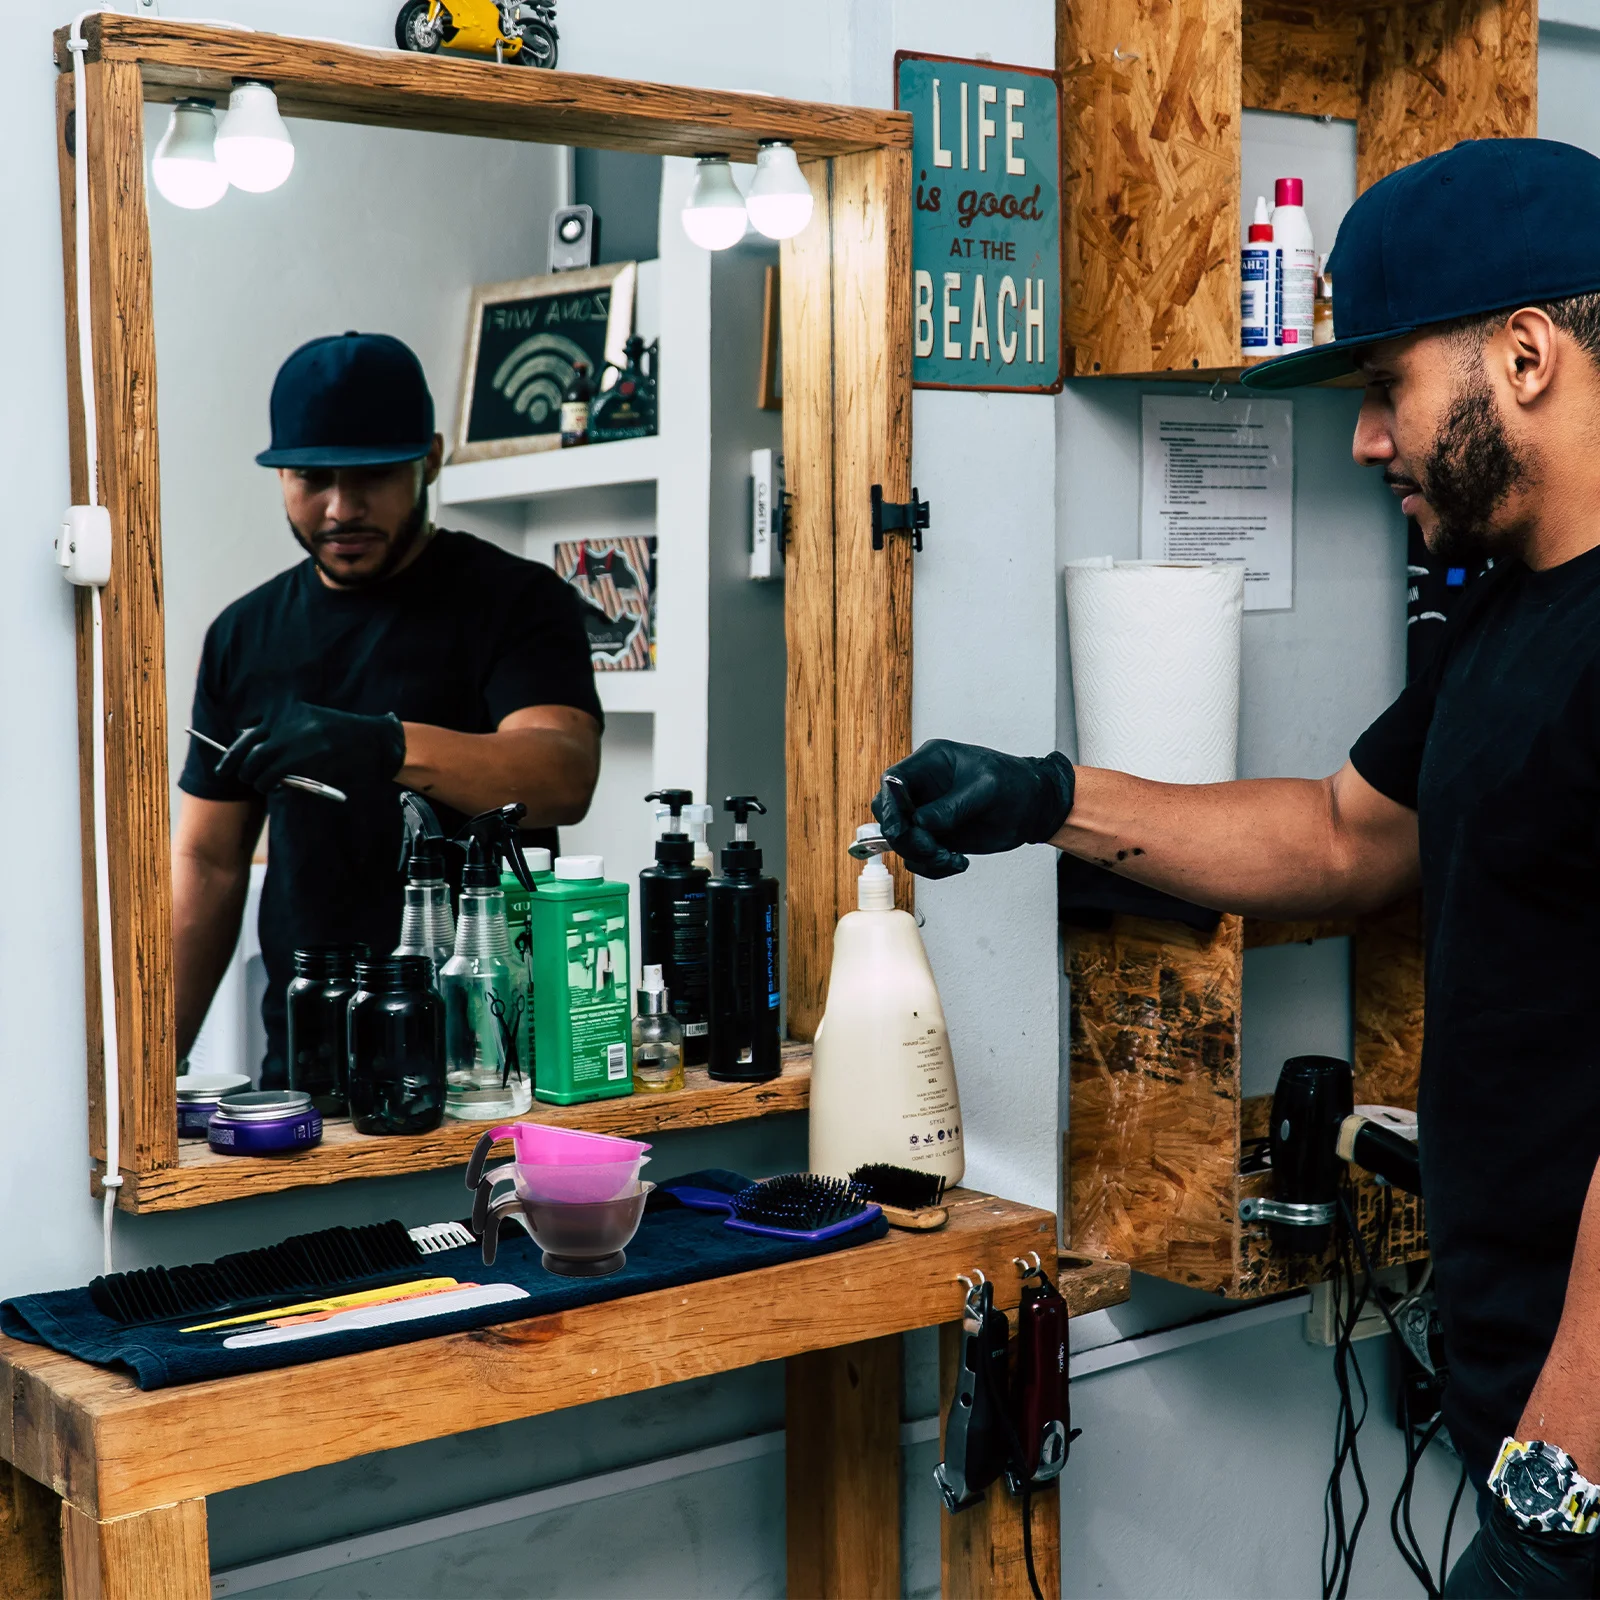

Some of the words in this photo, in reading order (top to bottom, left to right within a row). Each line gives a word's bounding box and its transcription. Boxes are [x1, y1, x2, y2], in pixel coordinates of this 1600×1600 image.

[932, 78, 1026, 176] LIFE
[916, 169, 942, 212] is
[957, 183, 1043, 228] good
[949, 237, 975, 258] AT
[979, 239, 1017, 261] THE
[1242, 260, 1264, 270] AHL
[914, 269, 1045, 364] BEACH
[765, 936, 774, 993] SHAVING
